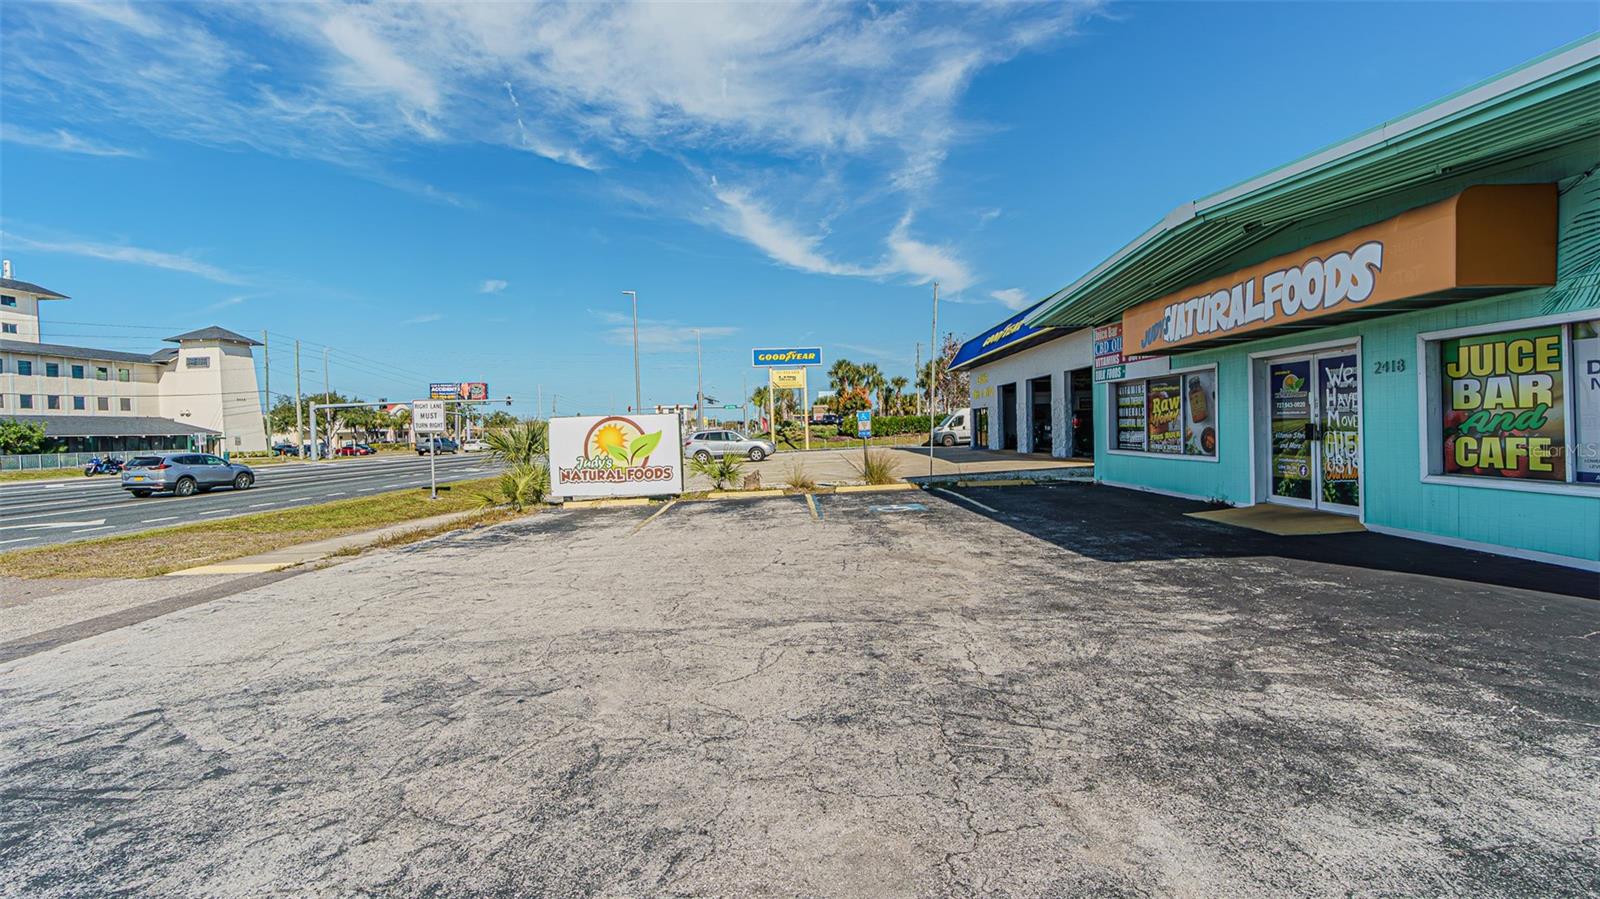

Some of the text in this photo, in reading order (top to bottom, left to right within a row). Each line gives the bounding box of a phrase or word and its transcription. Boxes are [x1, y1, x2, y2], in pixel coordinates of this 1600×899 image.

[1163, 278, 1265, 345] NATURAL
[1263, 240, 1384, 321] FOODS
[758, 351, 816, 362] GOODYEAR
[1095, 340, 1110, 355] CBD
[1446, 335, 1561, 378] JUICE
[1325, 362, 1354, 387] We
[1152, 395, 1180, 414] Raw
[1452, 374, 1554, 410] BAR
[1458, 402, 1550, 434] And
[576, 455, 613, 470] Judy's
[1454, 435, 1554, 472] CAFE
[560, 466, 673, 482] NATURAL FOODS
